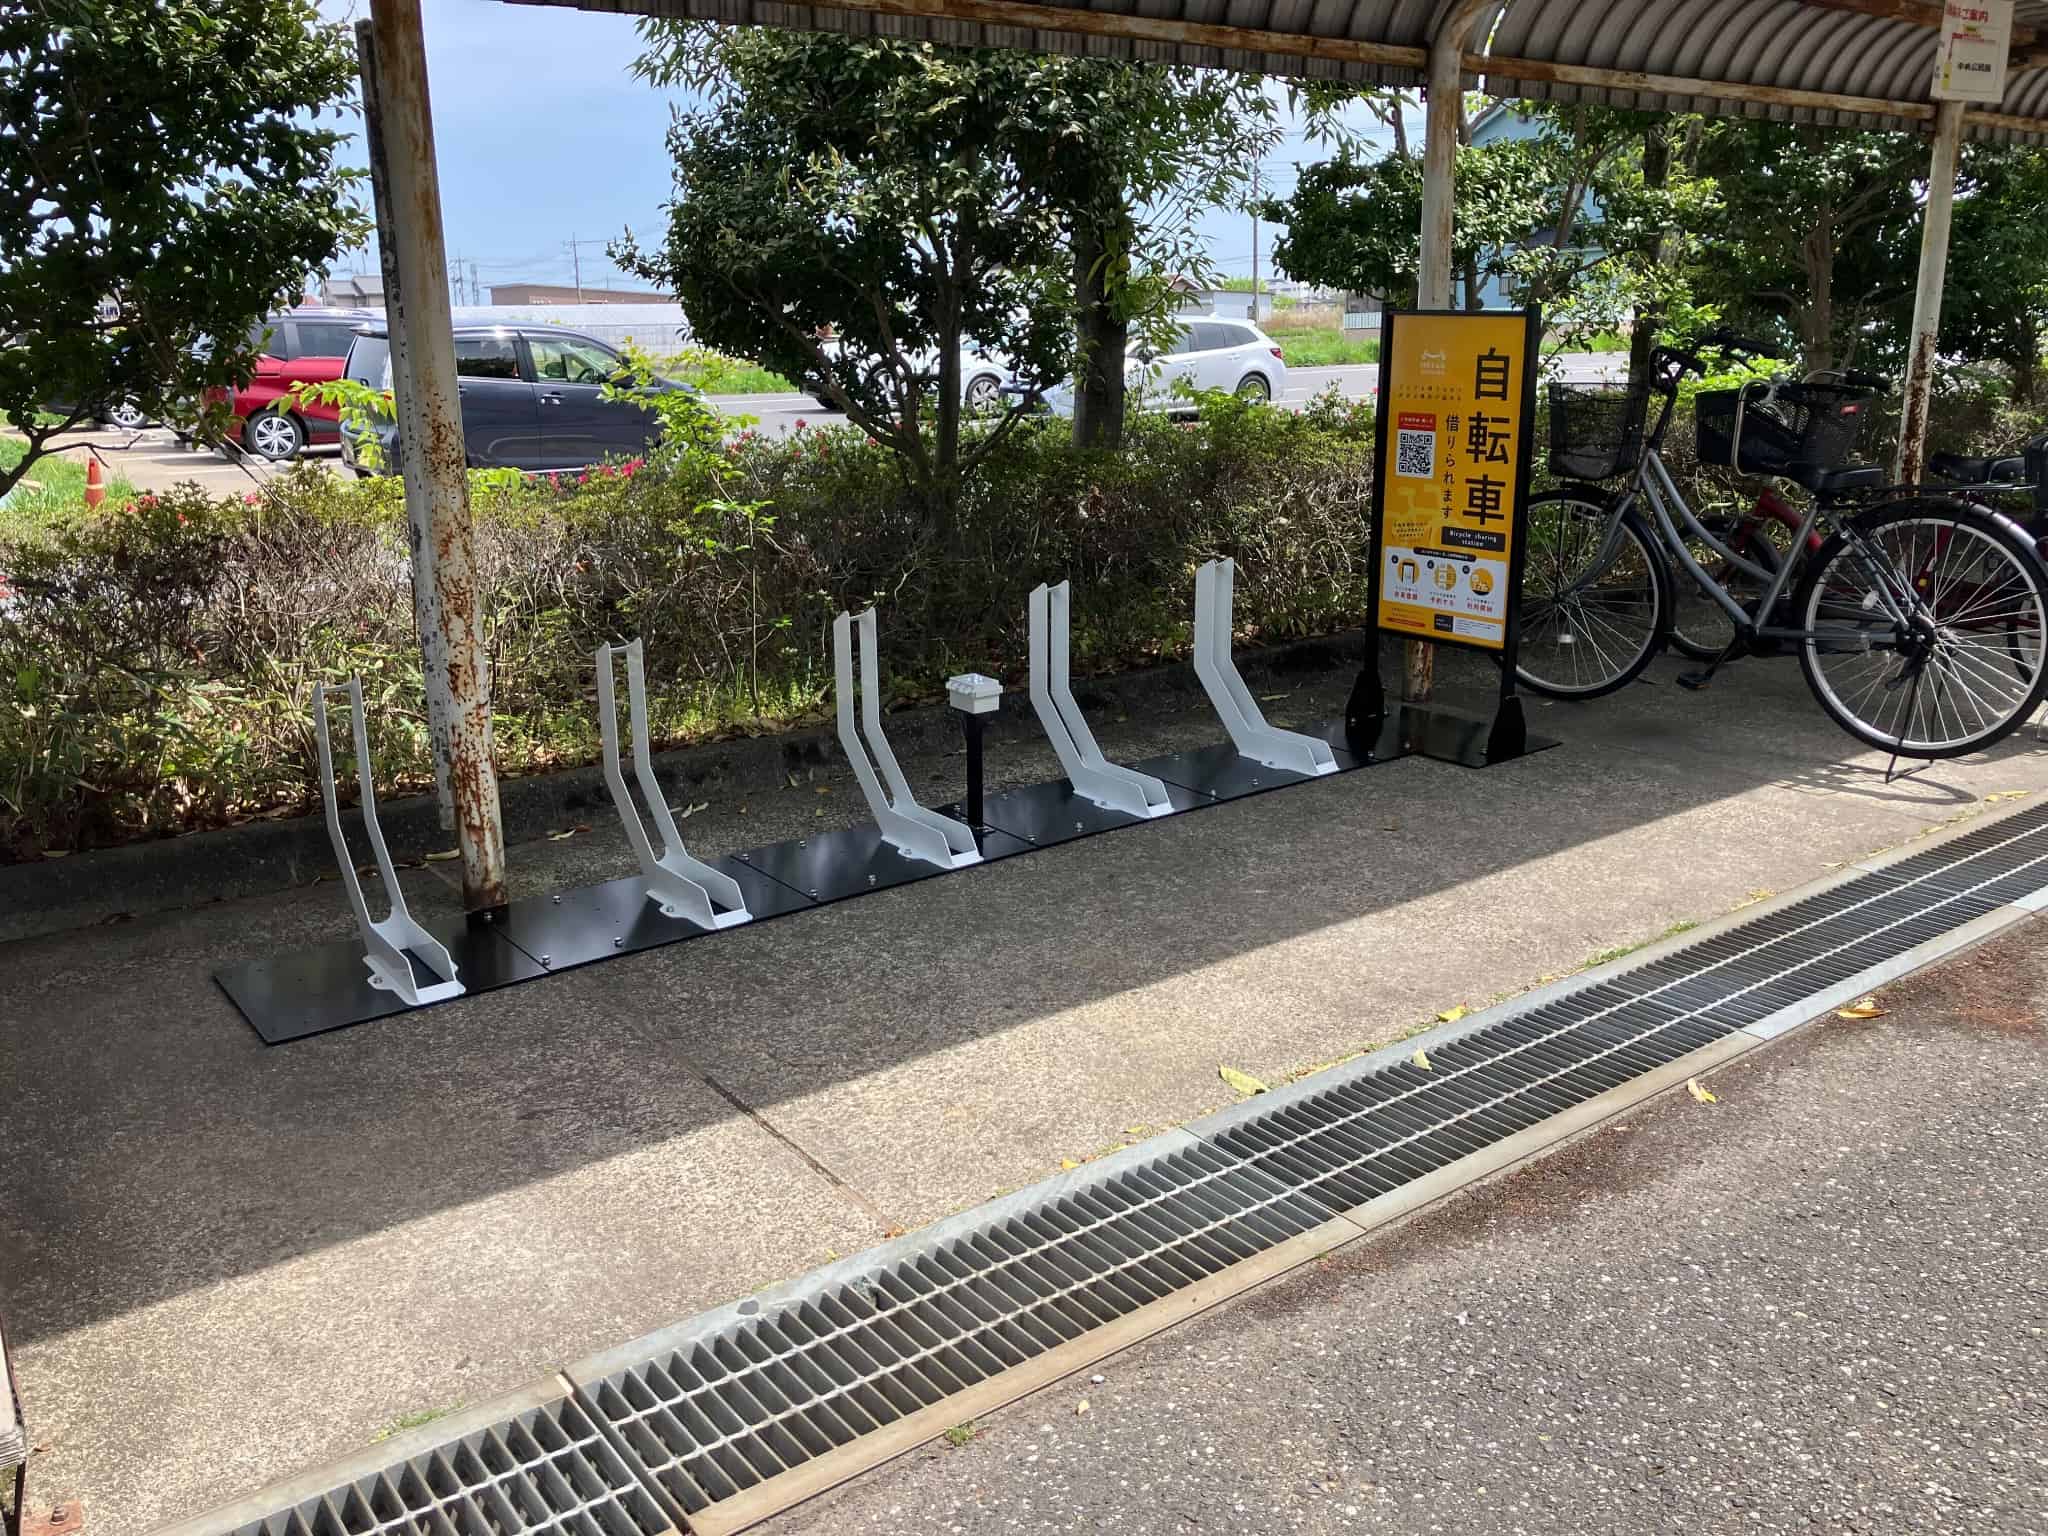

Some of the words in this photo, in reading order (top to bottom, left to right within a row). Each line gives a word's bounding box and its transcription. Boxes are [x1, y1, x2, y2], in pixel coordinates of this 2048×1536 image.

[1441, 414, 1460, 519] 借りられます
[1462, 347, 1511, 525] 自転車
[1449, 529, 1471, 539] Bicycle
